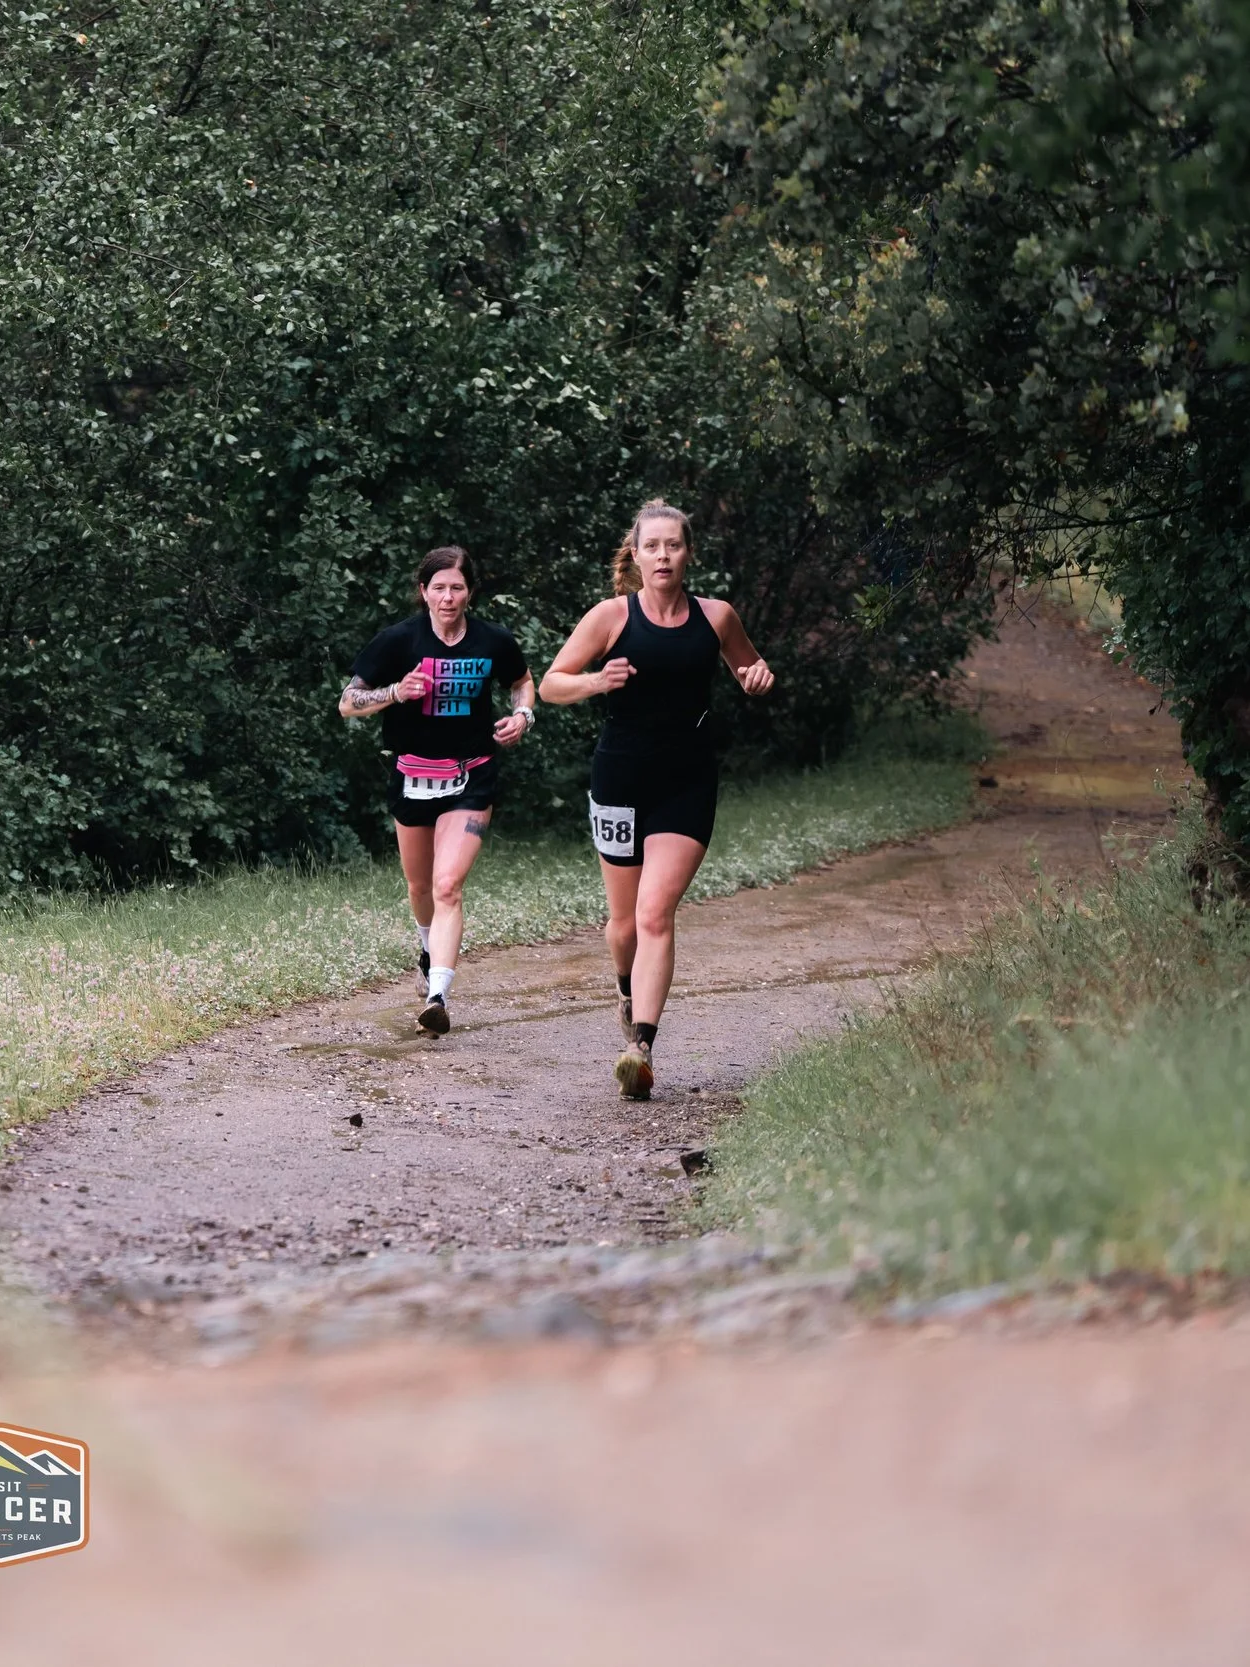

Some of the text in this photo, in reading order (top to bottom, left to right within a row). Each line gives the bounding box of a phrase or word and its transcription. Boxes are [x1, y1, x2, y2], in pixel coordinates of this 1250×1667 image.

[440, 661, 486, 675] PARK
[439, 681, 478, 695] CITY
[437, 700, 463, 713] FIT
[593, 815, 632, 844] 158
